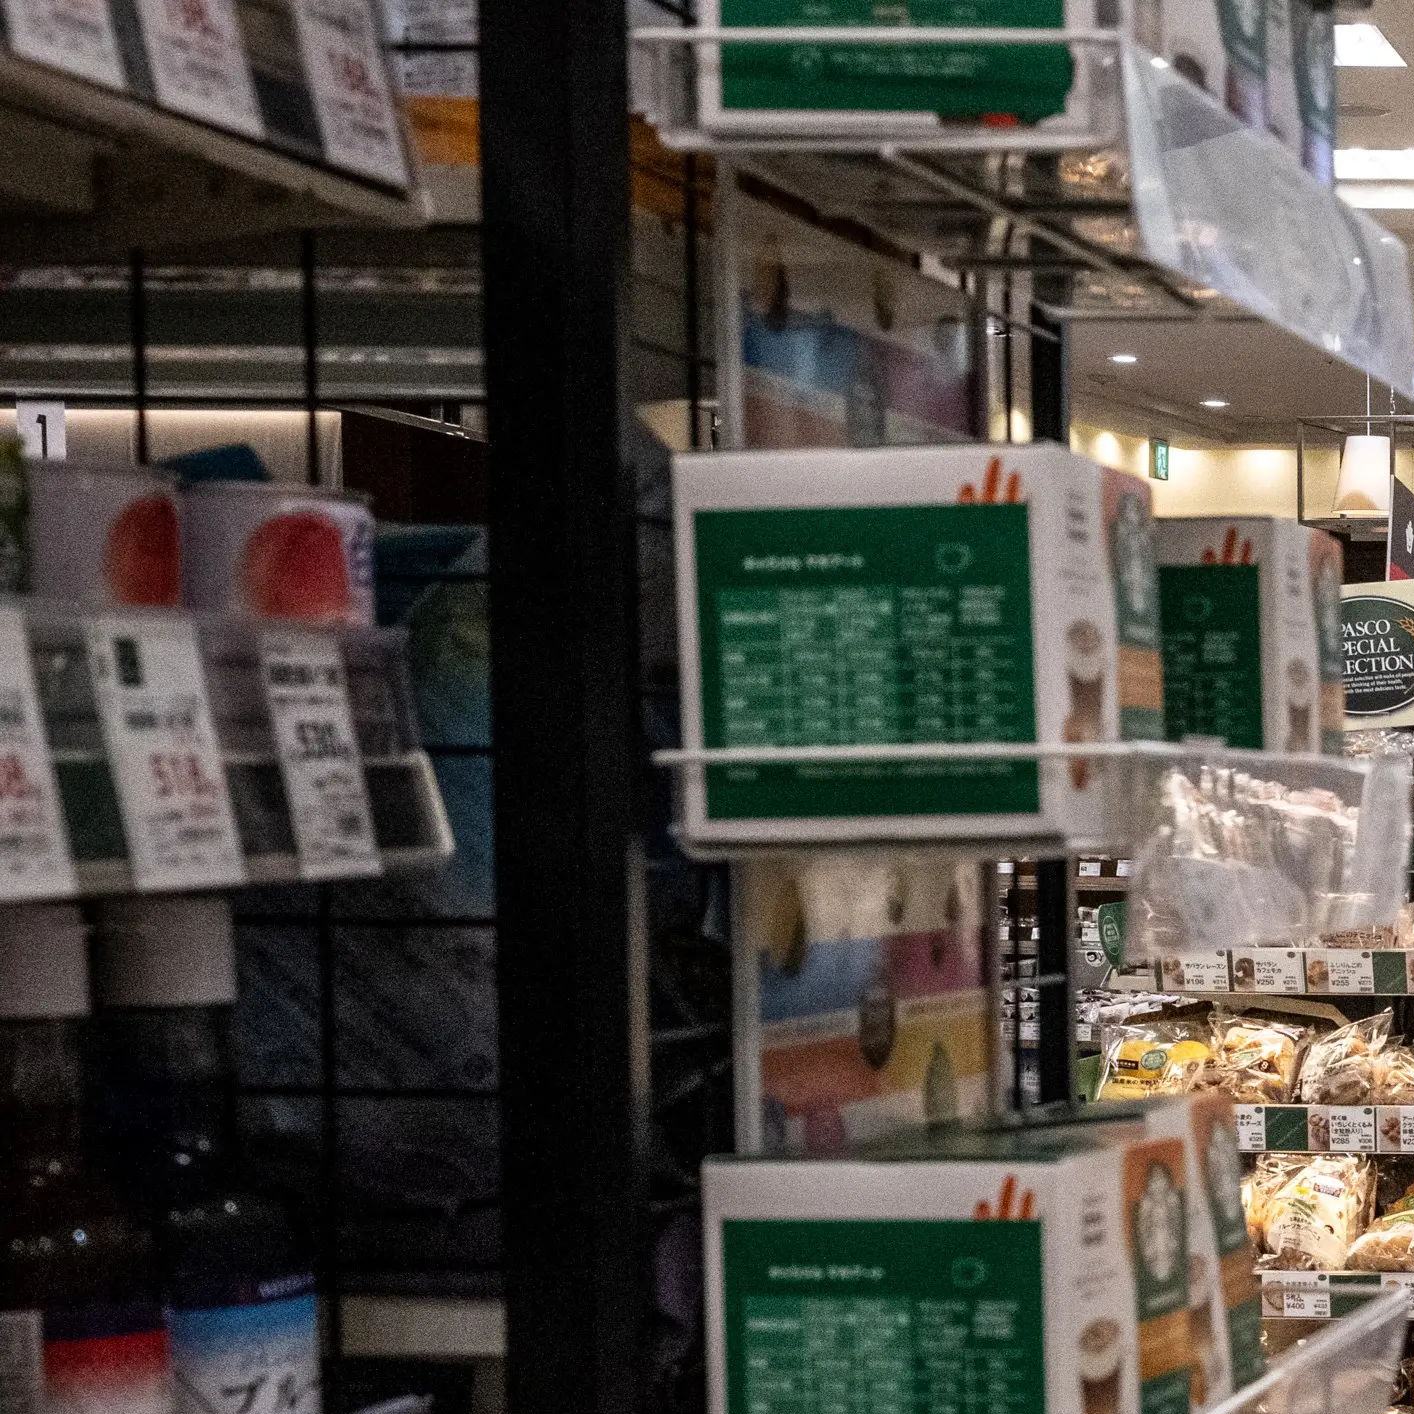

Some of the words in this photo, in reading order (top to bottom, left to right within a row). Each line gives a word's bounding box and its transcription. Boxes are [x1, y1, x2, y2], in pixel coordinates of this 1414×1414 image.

[1341, 637, 1400, 656] PECIAL
[1341, 654, 1414, 675] ECTION
[1256, 978, 1275, 986] ¥250
